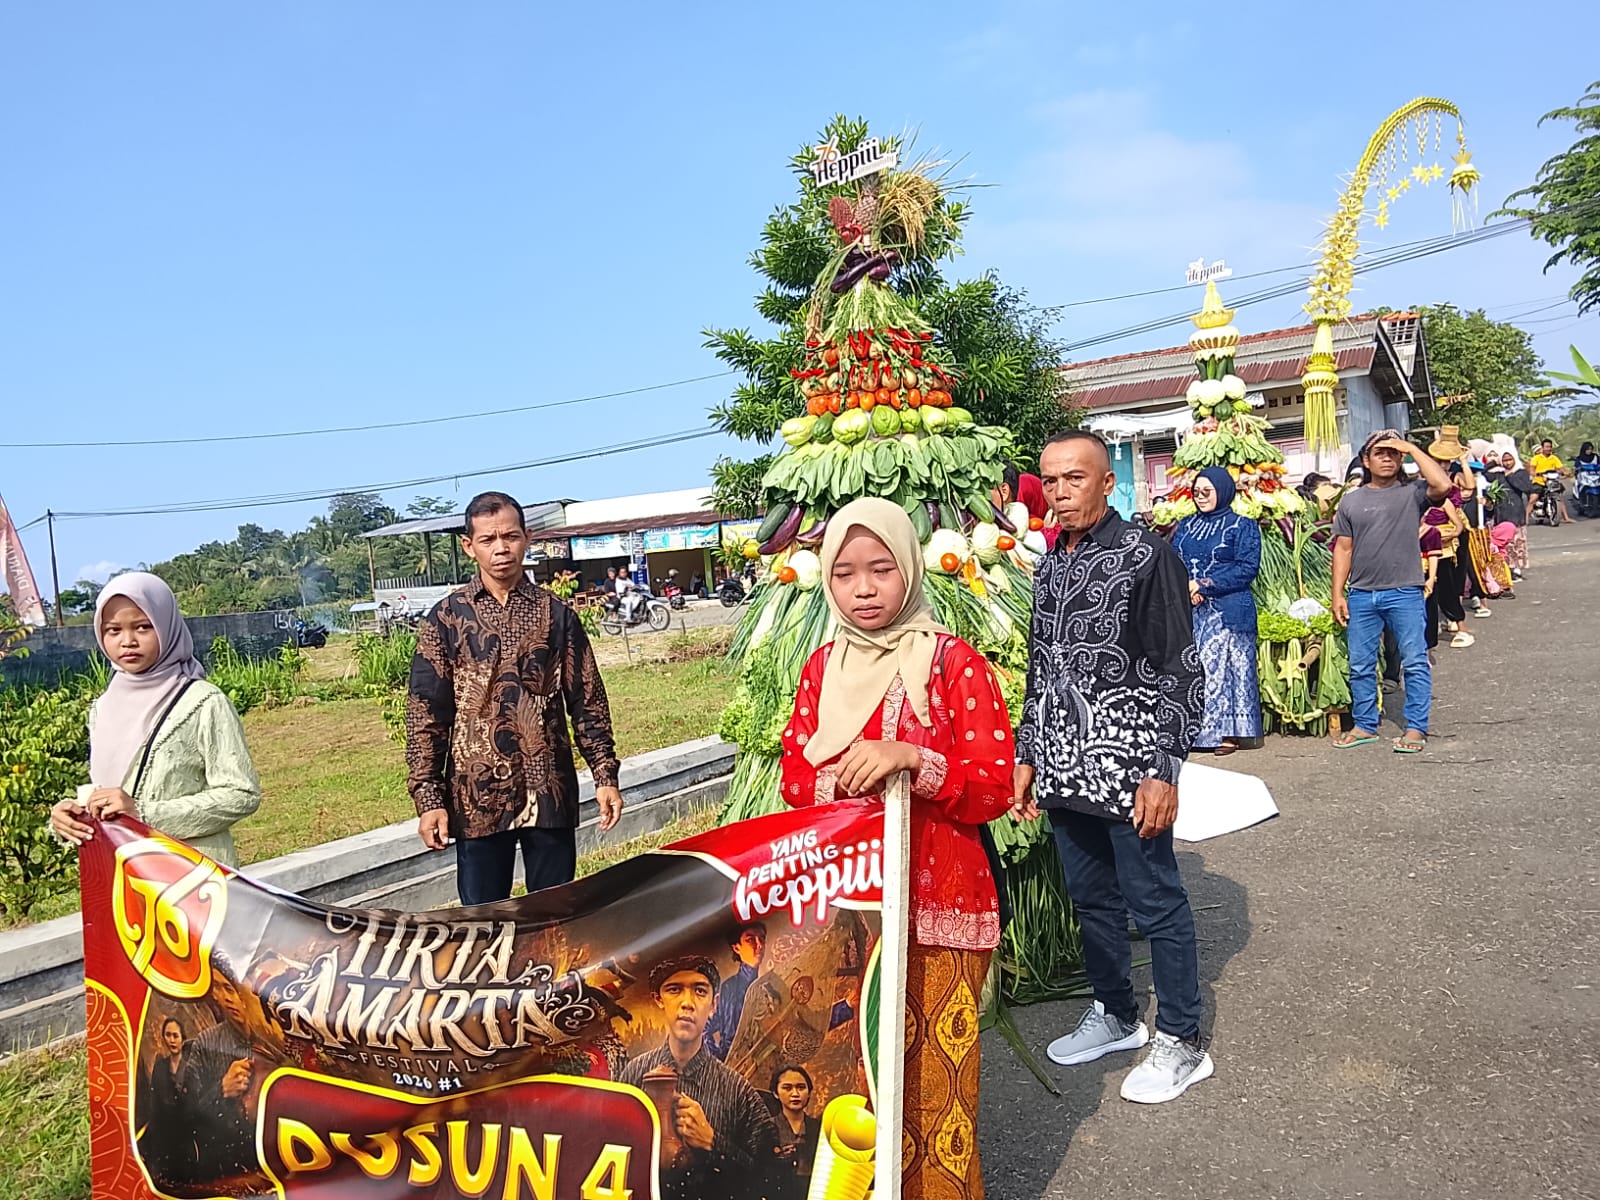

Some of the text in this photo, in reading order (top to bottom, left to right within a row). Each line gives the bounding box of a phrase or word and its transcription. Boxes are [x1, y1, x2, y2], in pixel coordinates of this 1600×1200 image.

[812, 139, 884, 183] Heppiii
[747, 845, 838, 887] PENTING
[770, 829, 818, 860] YANG
[735, 838, 883, 925] heppiii
[326, 909, 528, 990] TIRTA
[276, 946, 584, 1057] AMARTA
[360, 1052, 478, 1073] FESTIVAL
[393, 1072, 464, 1092] 2026 #1
[277, 1116, 632, 1200] DUSUN 4
